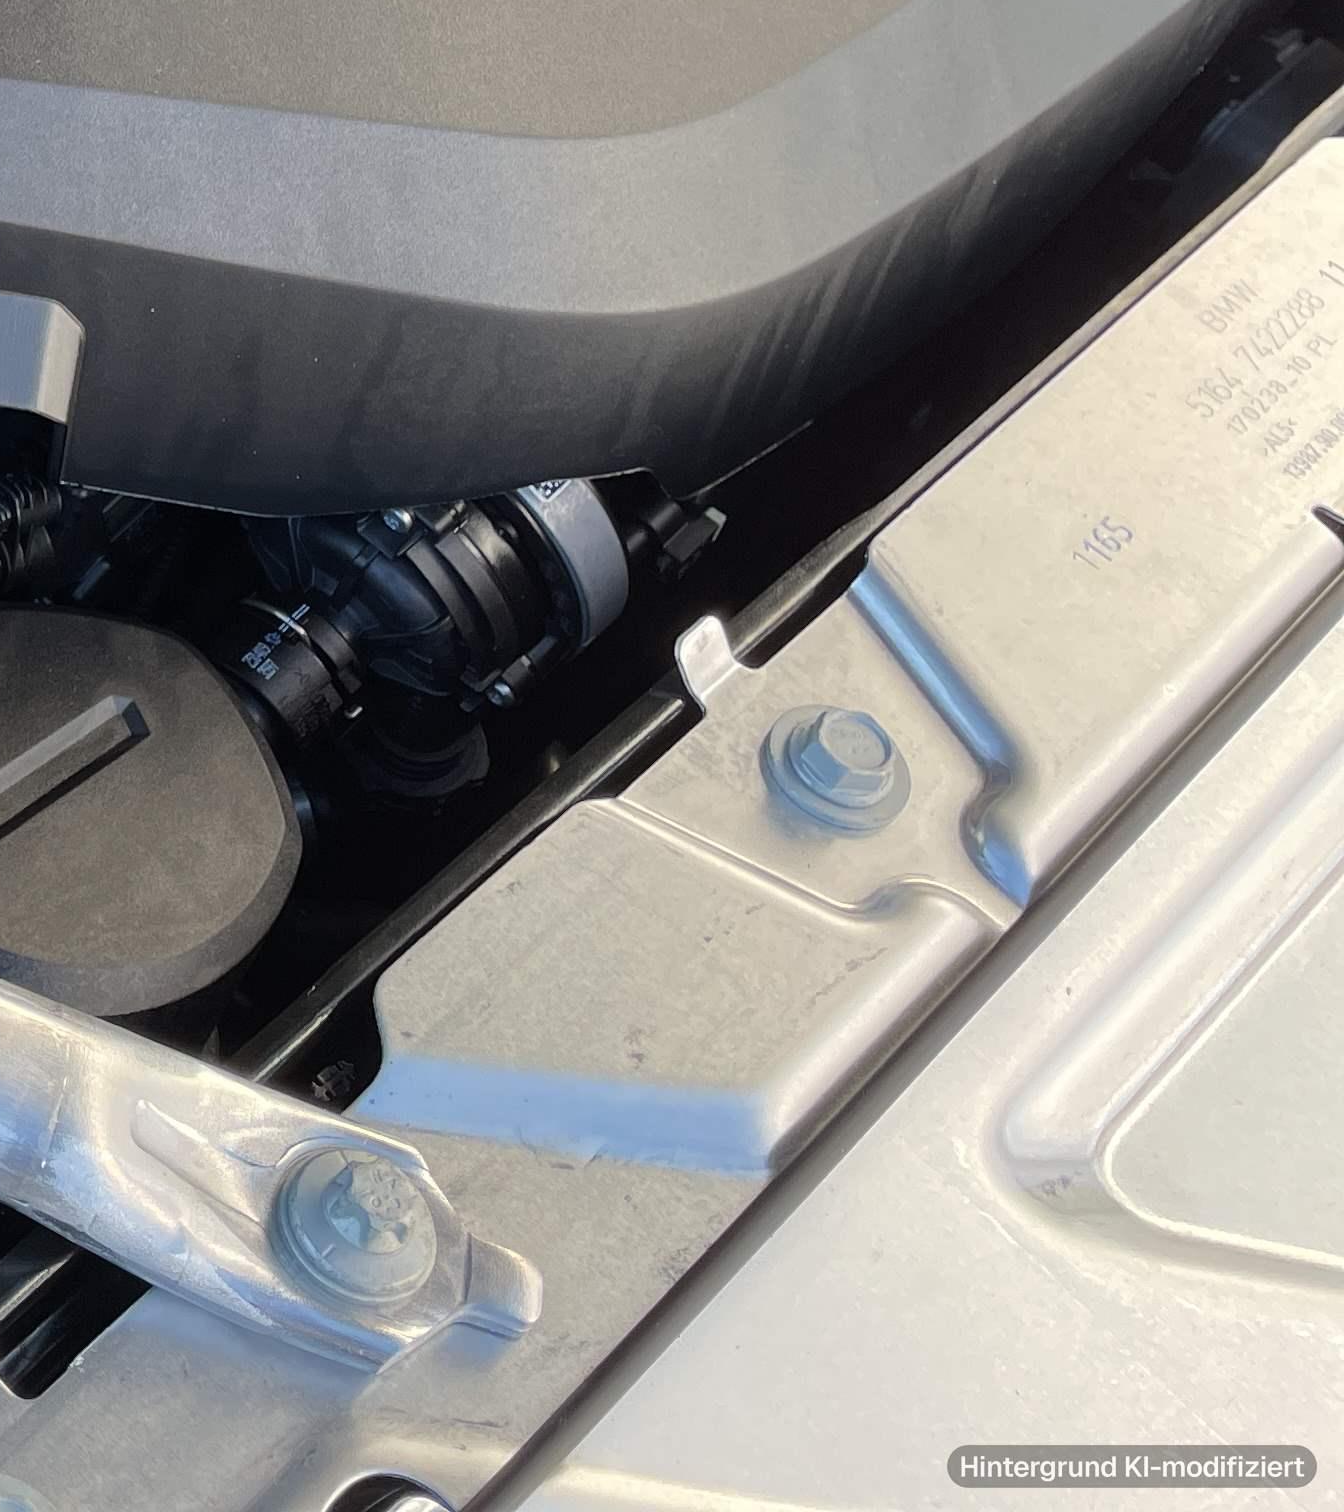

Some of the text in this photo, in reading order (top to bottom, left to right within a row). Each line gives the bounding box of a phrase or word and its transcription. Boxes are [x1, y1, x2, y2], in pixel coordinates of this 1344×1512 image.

[1198, 278, 1259, 334] BMW
[1185, 367, 1244, 419] 5164
[1233, 286, 1326, 372] 7422288
[1072, 515, 1134, 572] 1165
